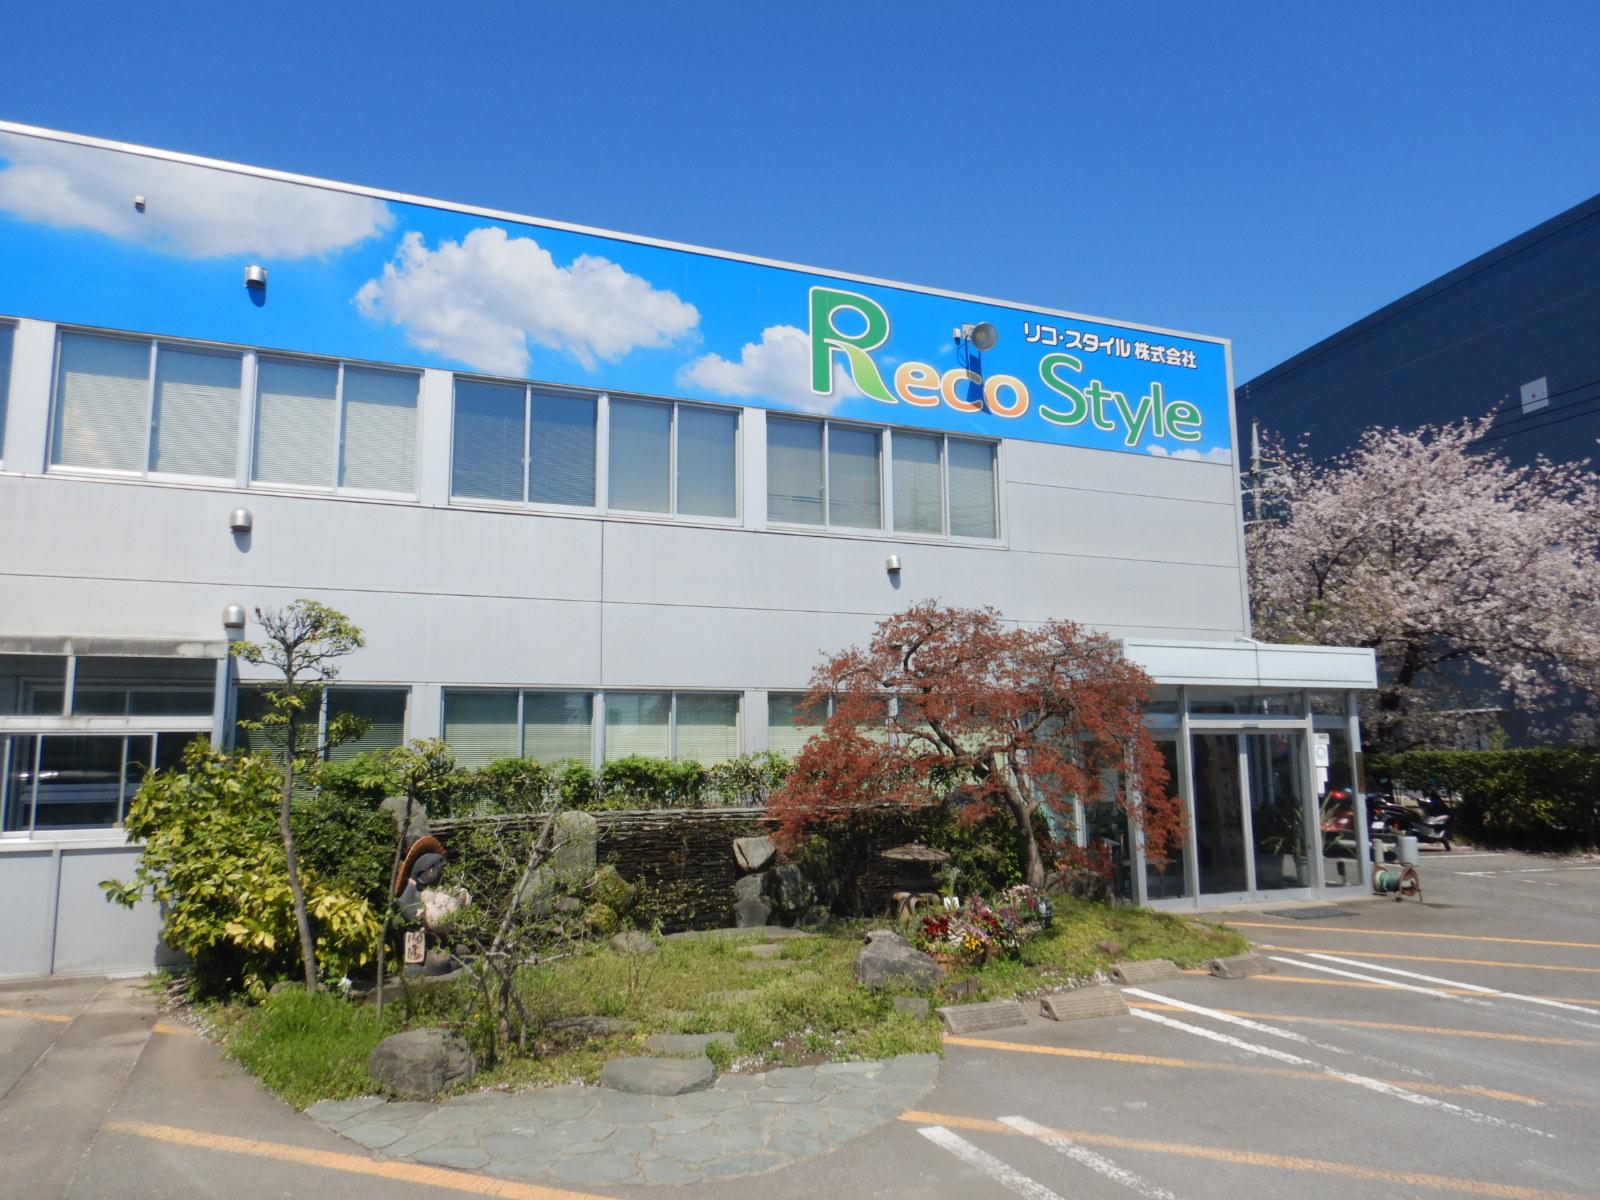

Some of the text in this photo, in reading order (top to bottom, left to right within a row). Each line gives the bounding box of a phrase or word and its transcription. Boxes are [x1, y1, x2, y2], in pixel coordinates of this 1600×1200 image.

[809, 286, 1203, 447] Reco Style
[1024, 322, 1197, 368] リコ・スタイル 株式会社
